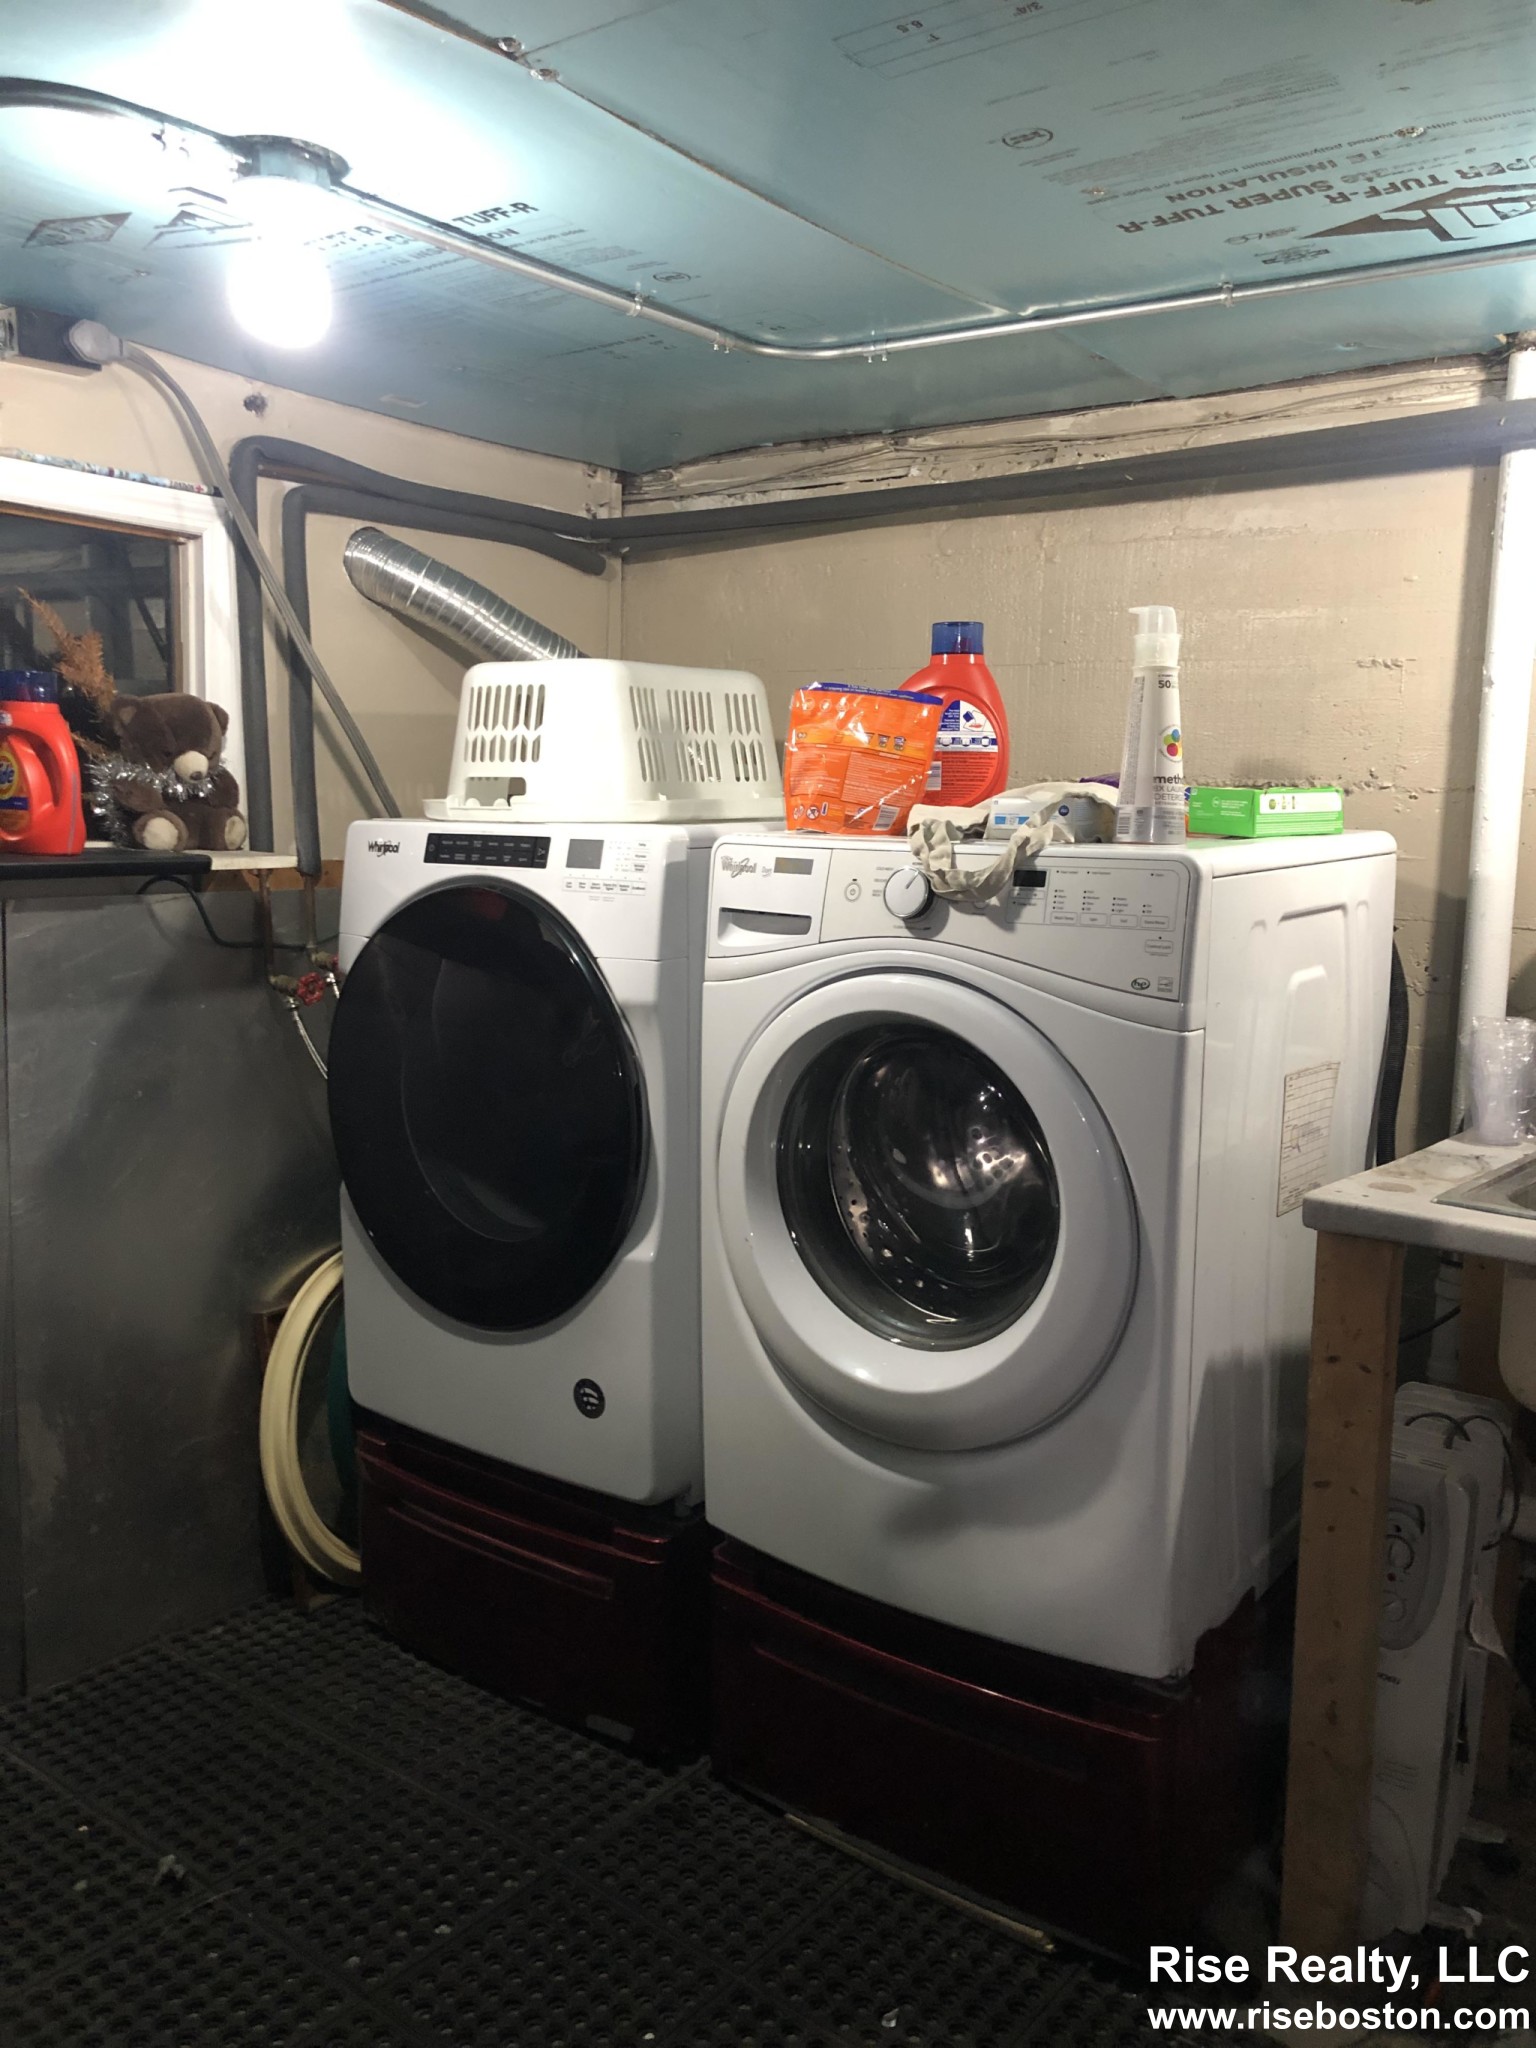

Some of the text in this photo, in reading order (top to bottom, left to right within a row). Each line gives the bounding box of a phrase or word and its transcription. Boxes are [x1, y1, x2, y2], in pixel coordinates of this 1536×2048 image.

[1165, 160, 1338, 204] INSULATION
[1324, 174, 1449, 205] TUFF-R
[452, 201, 540, 227] TUFF-R
[1116, 180, 1330, 234] SUPER TUFF-R
[1158, 679, 1172, 689] 50
[368, 839, 400, 857] Whirlpool
[720, 855, 758, 879] Whirlpool
